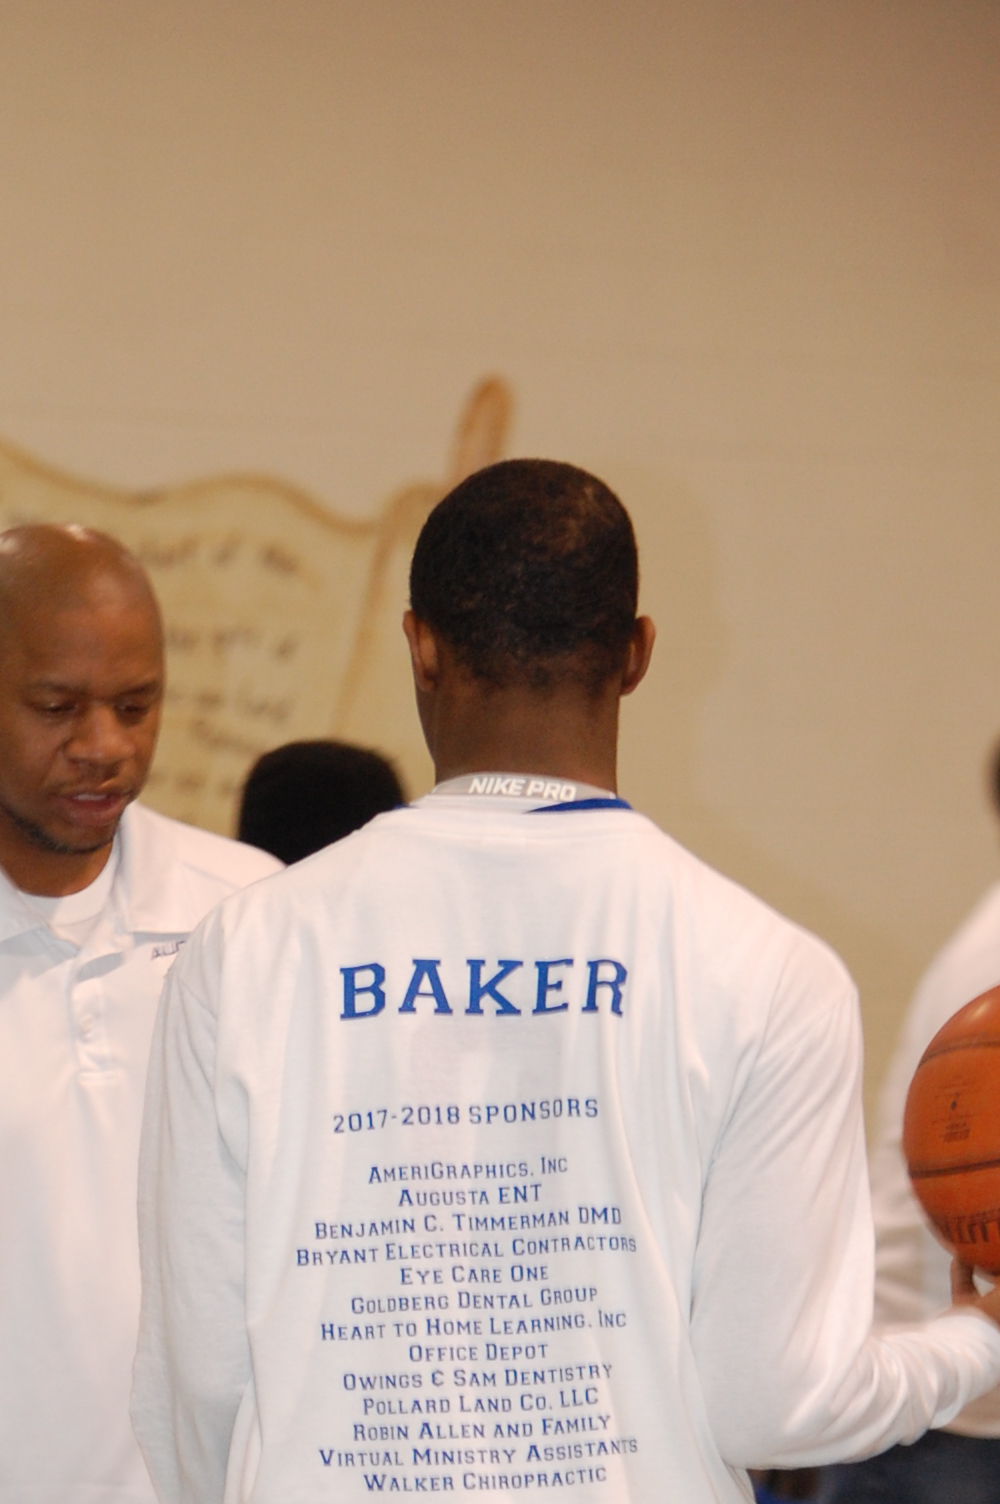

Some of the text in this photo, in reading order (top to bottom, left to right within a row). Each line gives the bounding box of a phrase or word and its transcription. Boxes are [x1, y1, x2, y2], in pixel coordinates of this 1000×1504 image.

[468, 777, 578, 801] NIKE PRO
[339, 957, 629, 1021] BAKER
[333, 1097, 599, 1134] 2017-2018 SPONSORS
[540, 1155, 568, 1175] INC
[398, 1183, 542, 1207] AUGUSTA ENT
[314, 1206, 622, 1240] BENJAMIN C. TIMMERMAN DMD
[295, 1235, 637, 1267] BRYANT ELECTRICAL CONTRACTORS
[399, 1264, 549, 1286] EYE CARE ONE
[350, 1286, 598, 1315] GOLDBERG DENTAL GROUP
[320, 1322, 386, 1341] HEART
[393, 1322, 417, 1338] TO
[425, 1317, 482, 1336] HOME
[597, 1309, 627, 1328] INC
[408, 1342, 548, 1362] OFFICE DEPOT
[342, 1372, 423, 1391] OWINGS
[453, 1369, 496, 1387] SAM
[504, 1363, 613, 1387] DENTISTRY
[362, 1386, 599, 1416] POLLARD LAND CO. LLC
[352, 1415, 611, 1442] ROBIN ALLEN AND FAMILY
[318, 1438, 638, 1467] VIRTUAL MINISTRY ASSISTANTS
[363, 1466, 607, 1492] WALKER CHIROPRACTIC
